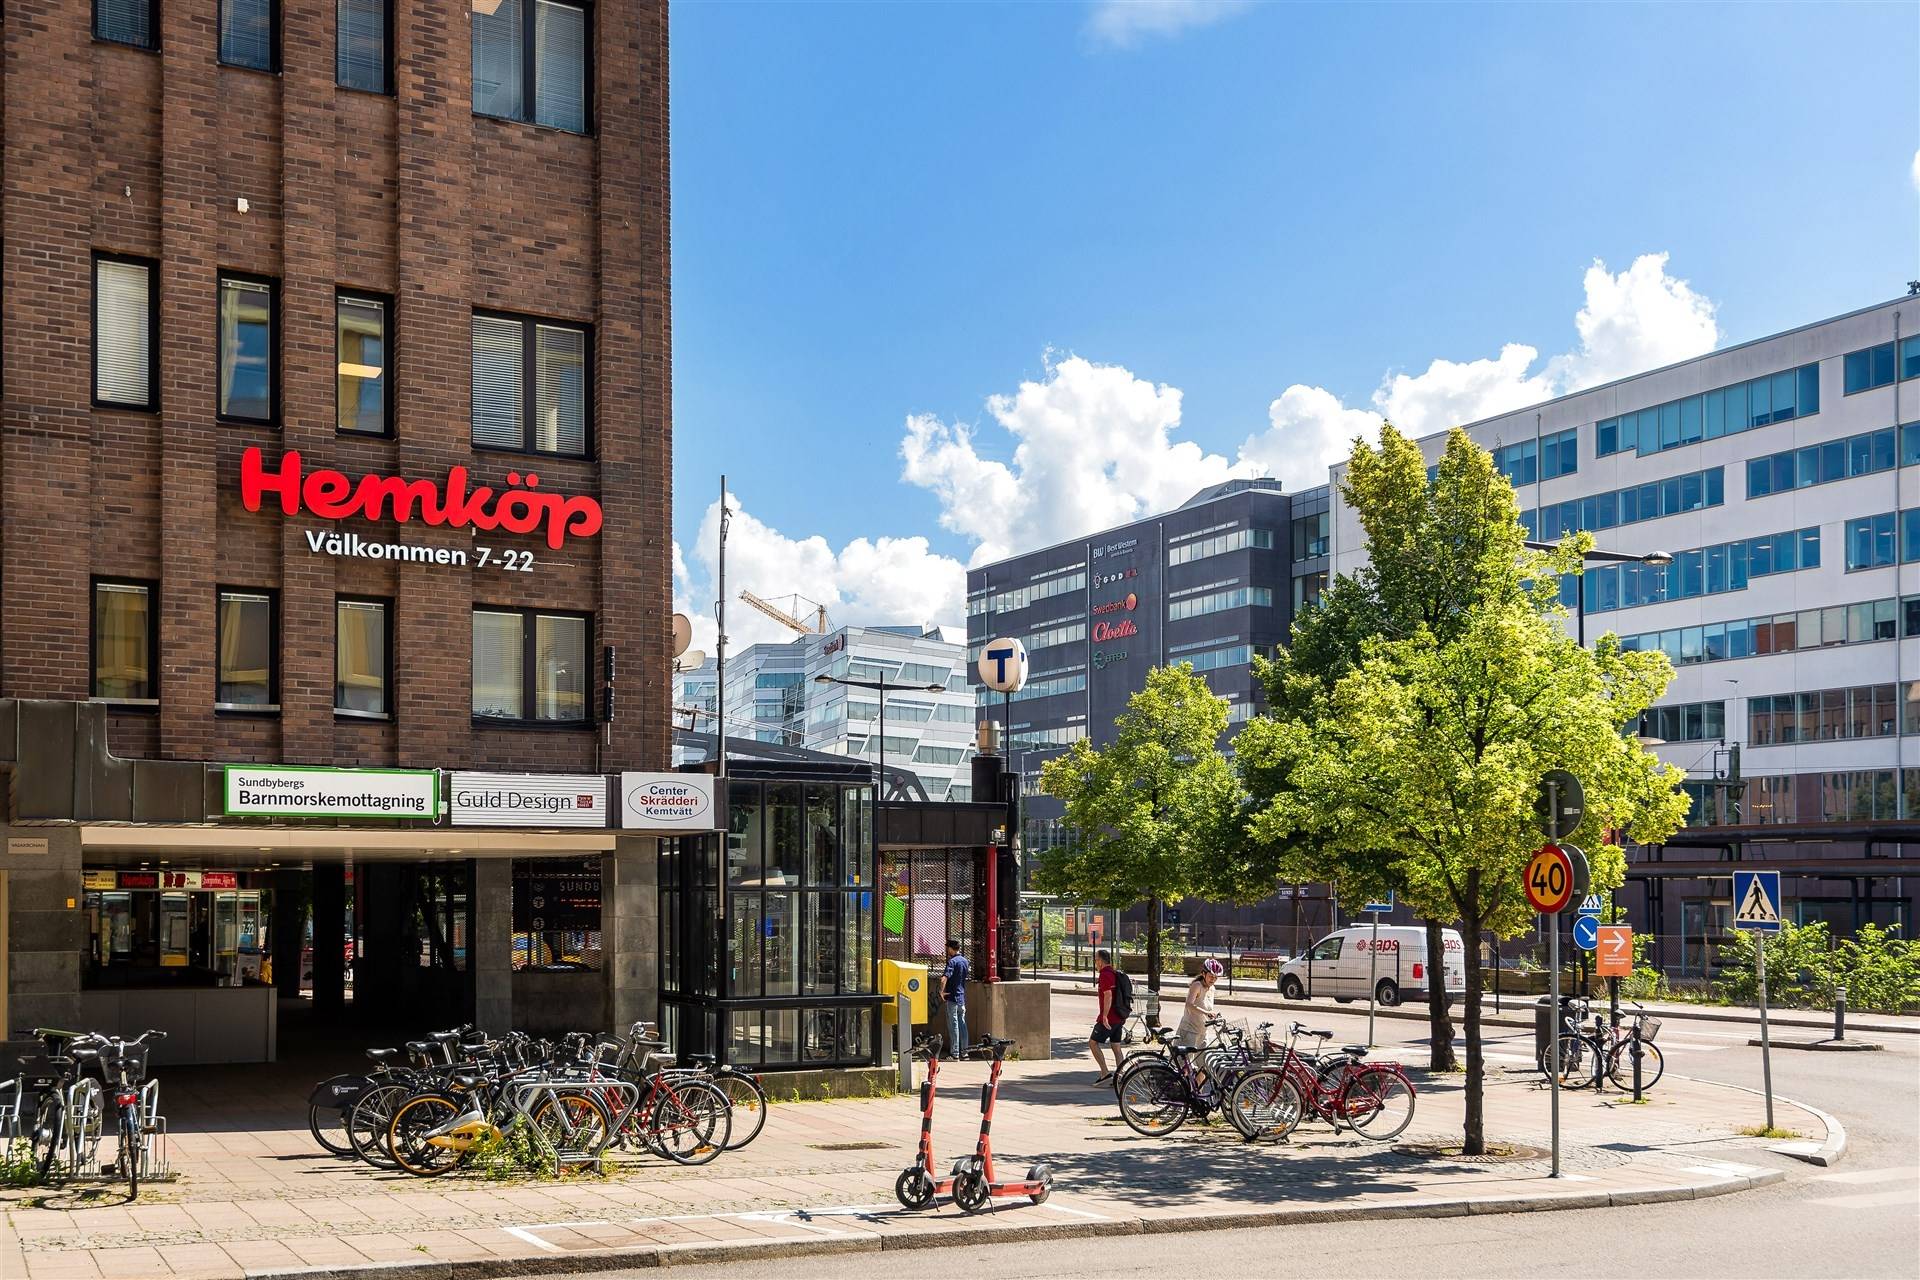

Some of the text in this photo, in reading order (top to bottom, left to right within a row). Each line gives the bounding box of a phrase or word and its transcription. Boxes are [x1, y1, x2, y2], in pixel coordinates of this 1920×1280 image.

[240, 446, 603, 550] Hemköp
[305, 530, 534, 573] Välkommen 7-22
[1093, 619, 1138, 643] Cloetta
[987, 648, 1013, 683] T
[238, 777, 305, 790] Sundbybergs
[649, 786, 688, 796] Center
[239, 790, 425, 811] Barnmorskemottagning
[457, 791, 501, 808] Guld
[508, 792, 571, 813] Design
[640, 795, 698, 806] Skrädderi
[646, 807, 692, 816] Kemtvätt
[1531, 862, 1565, 896] 40
[1368, 939, 1399, 953] saps
